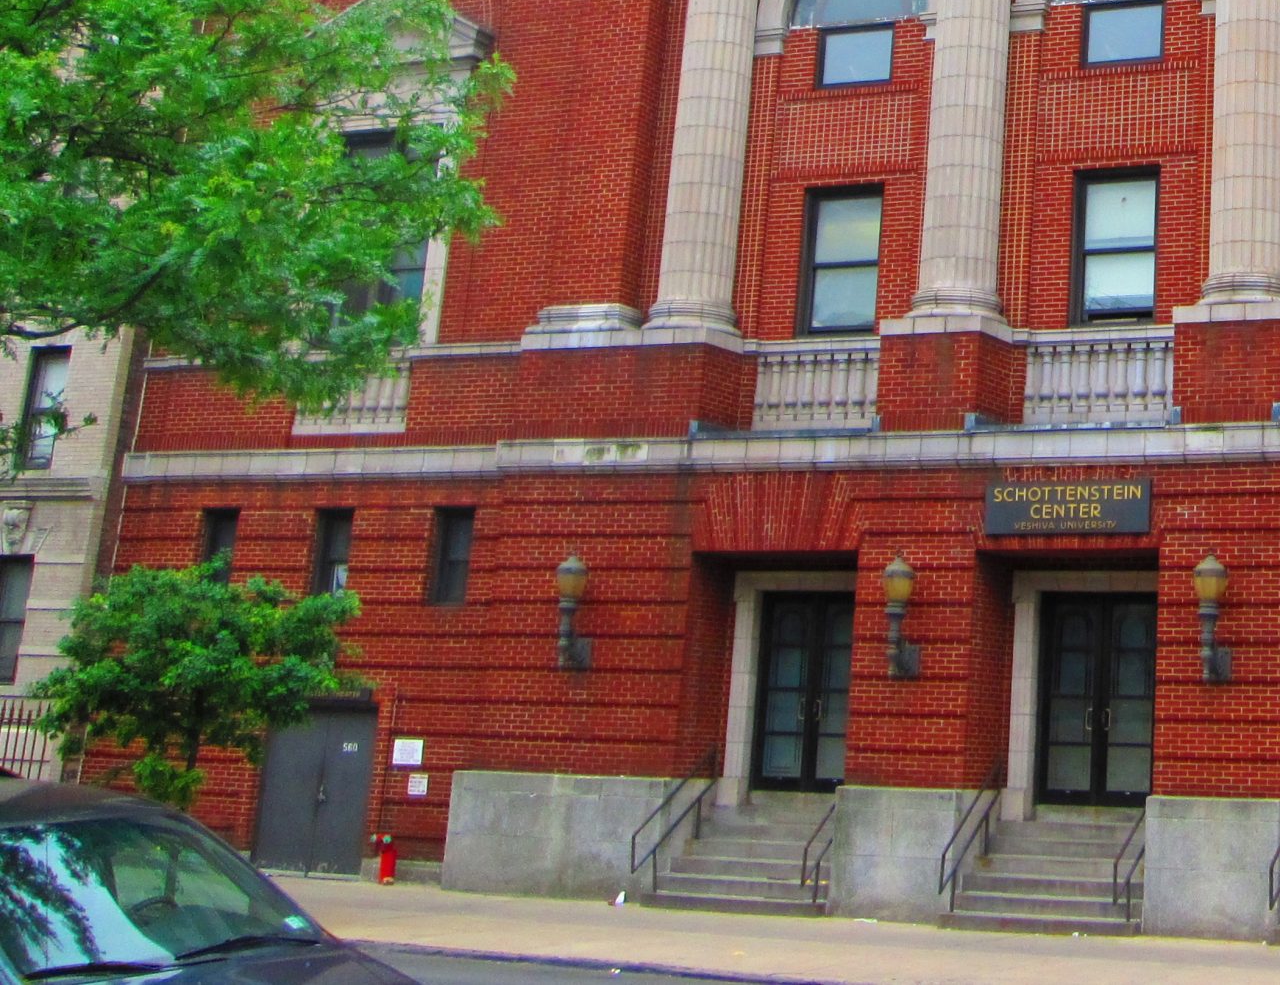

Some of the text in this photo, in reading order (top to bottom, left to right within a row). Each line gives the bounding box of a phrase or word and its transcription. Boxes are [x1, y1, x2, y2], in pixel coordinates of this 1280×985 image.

[993, 484, 1142, 503] SCHOTTENSTEIN
[1030, 503, 1102, 519] CENTER
[1014, 520, 1117, 531] YESHIVA UNIVERSITY
[343, 742, 358, 752] 560
